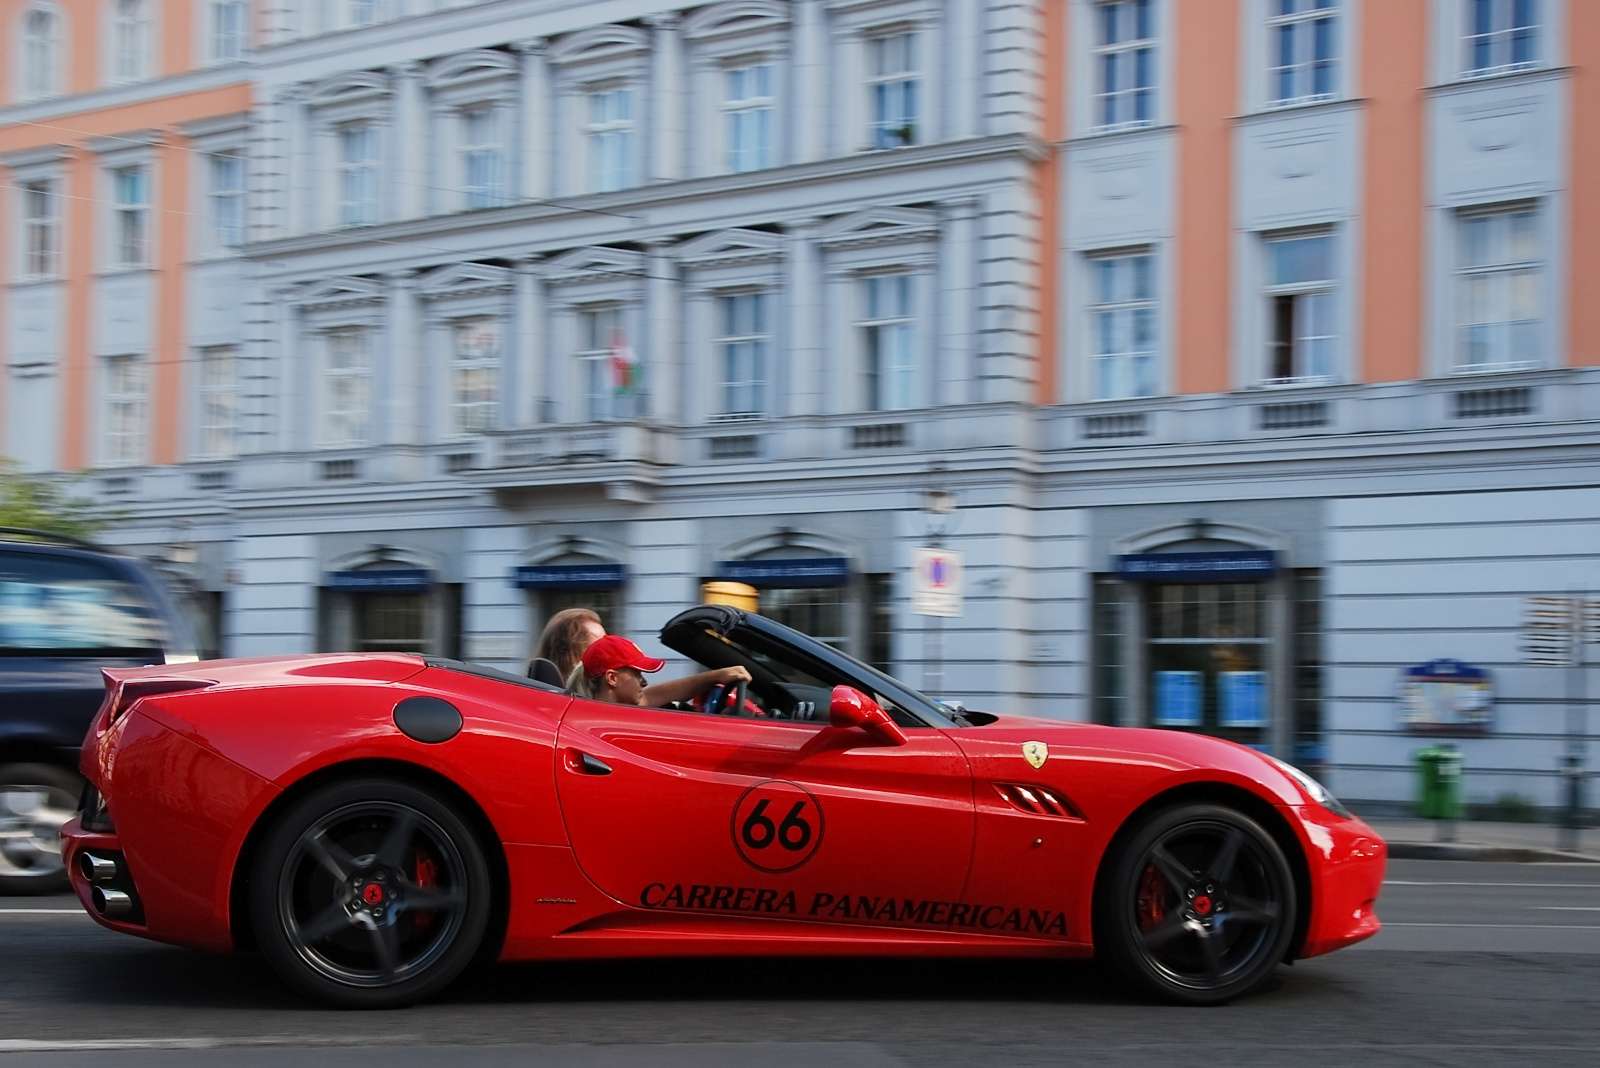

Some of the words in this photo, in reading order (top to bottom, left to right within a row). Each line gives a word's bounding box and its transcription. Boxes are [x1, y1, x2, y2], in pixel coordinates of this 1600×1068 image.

[742, 799, 811, 851] 66
[640, 882, 797, 913] CARRERA
[808, 893, 1067, 935] PANAMERICANA
